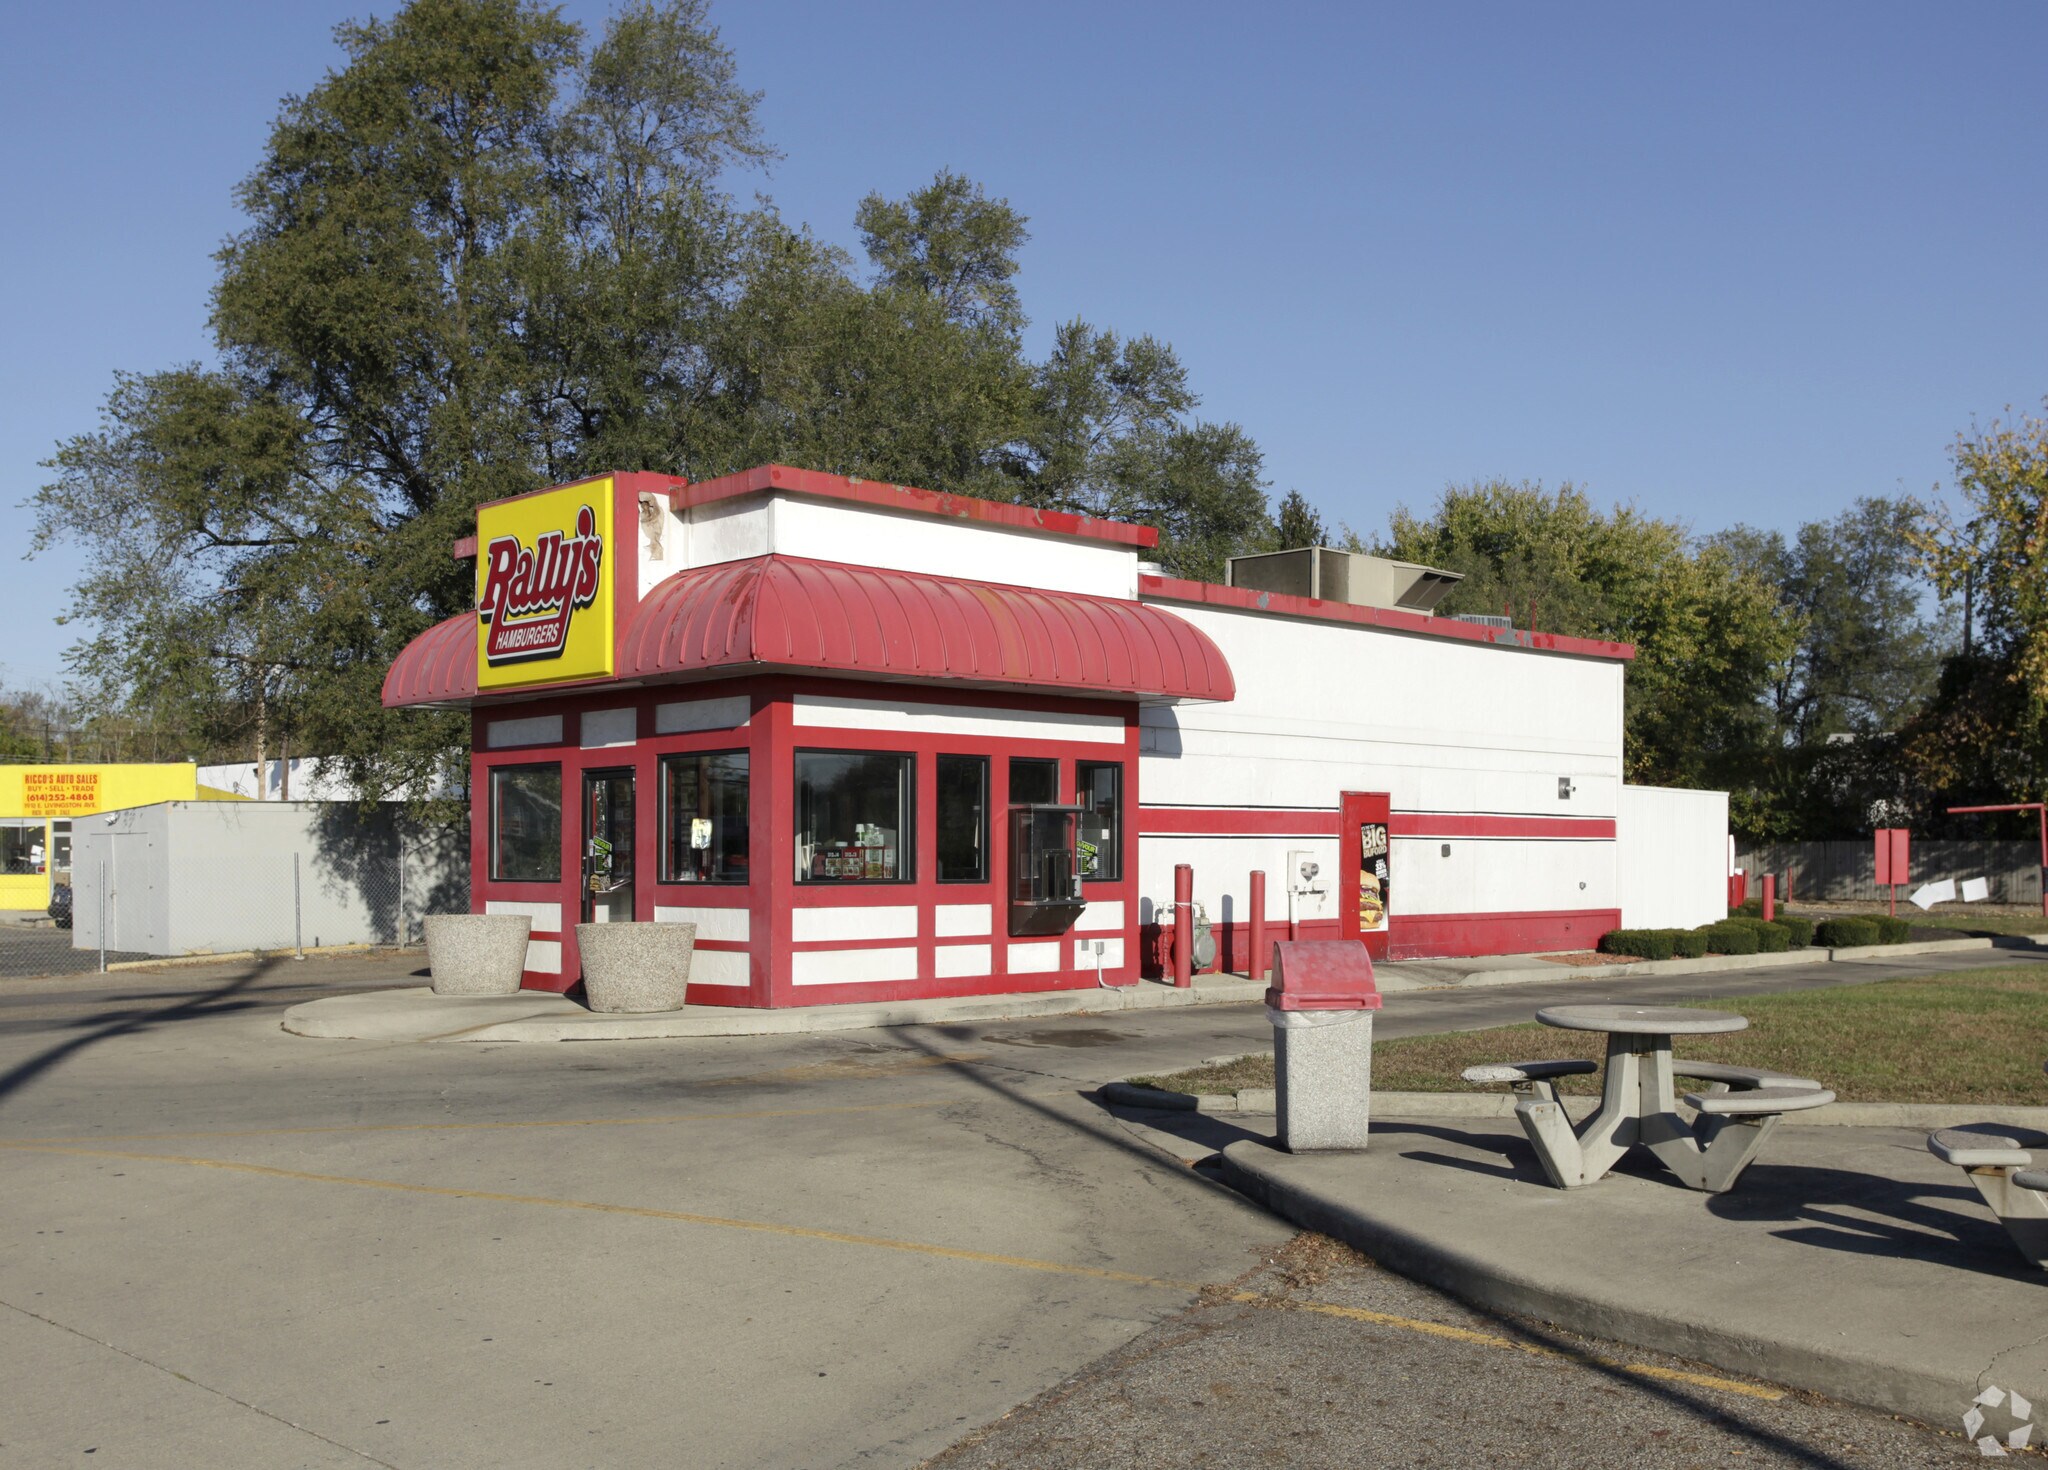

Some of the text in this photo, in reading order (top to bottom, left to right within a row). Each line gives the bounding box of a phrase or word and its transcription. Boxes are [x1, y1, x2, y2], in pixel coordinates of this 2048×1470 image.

[479, 504, 602, 622] Rally's
[495, 622, 560, 650] HAMBURGERS
[25, 774, 98, 784] RICCO'S AUTO SALES
[1362, 826, 1387, 849] BIG
[1363, 845, 1388, 858] BUFORD
